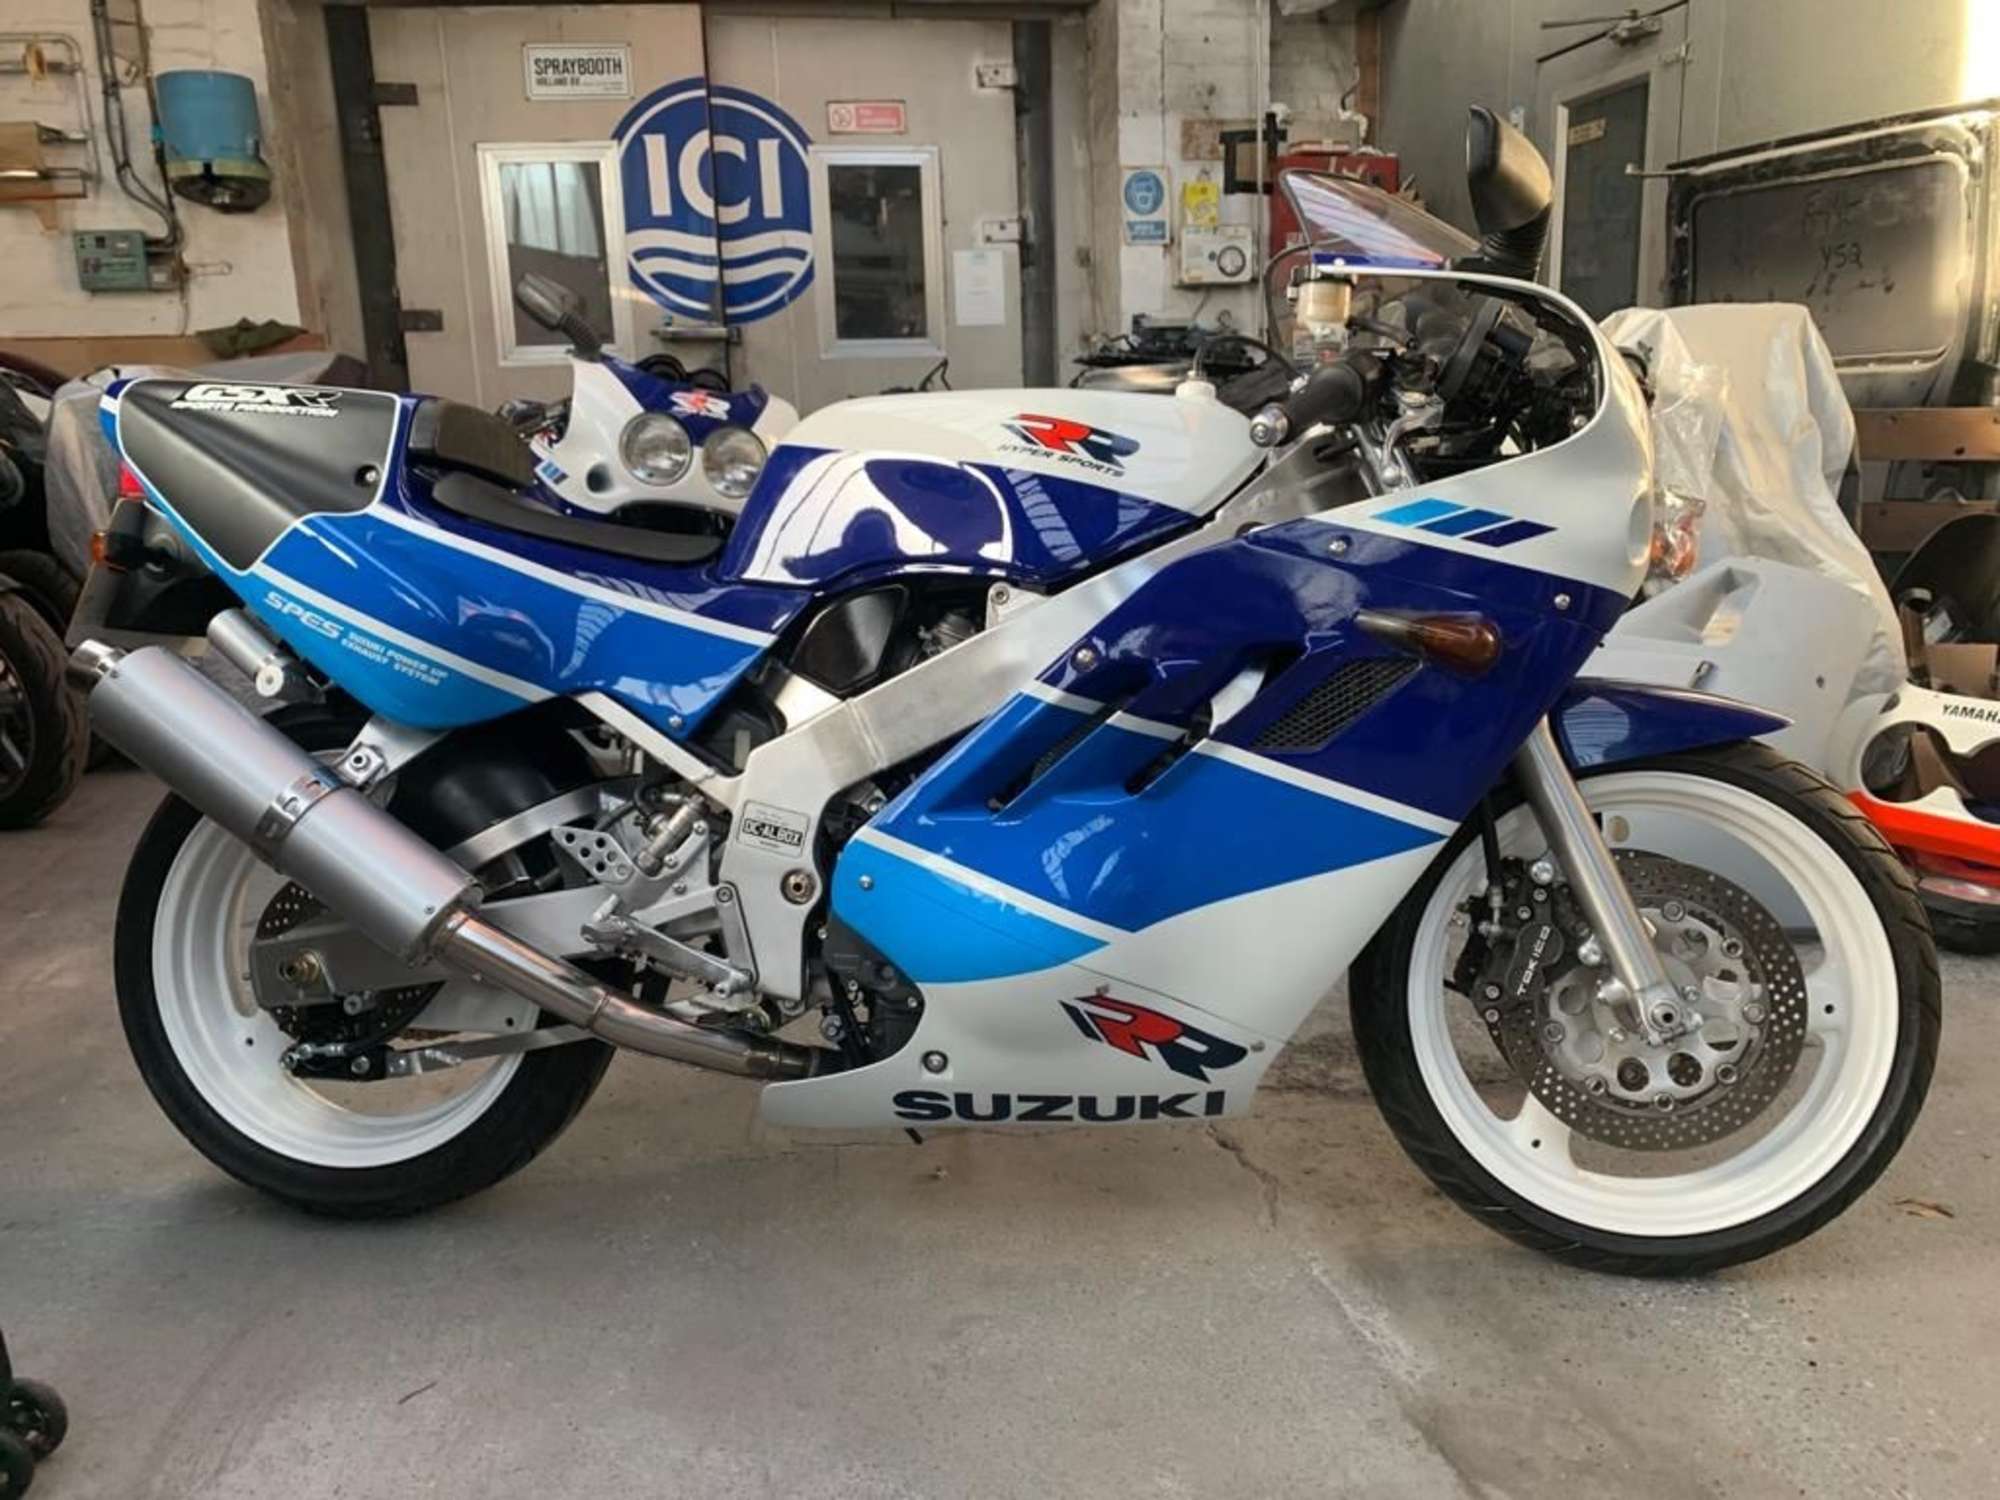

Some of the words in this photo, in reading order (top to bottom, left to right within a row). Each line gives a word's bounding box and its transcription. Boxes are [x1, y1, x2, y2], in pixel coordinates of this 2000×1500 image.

[533, 58, 622, 75] SPRAYBOOTH
[642, 128, 784, 225] ICI
[234, 402, 339, 418] PRODUCTION
[998, 444, 1054, 459] HYPER
[1057, 454, 1126, 478] SPORTS
[263, 590, 345, 640] SPES
[340, 637, 389, 665] EXHAUST
[393, 661, 442, 687] SYSTEM
[386, 648, 429, 674] POWER
[1516, 925, 1551, 996] TOKICO
[892, 1089, 1226, 1122] SUZUKI
